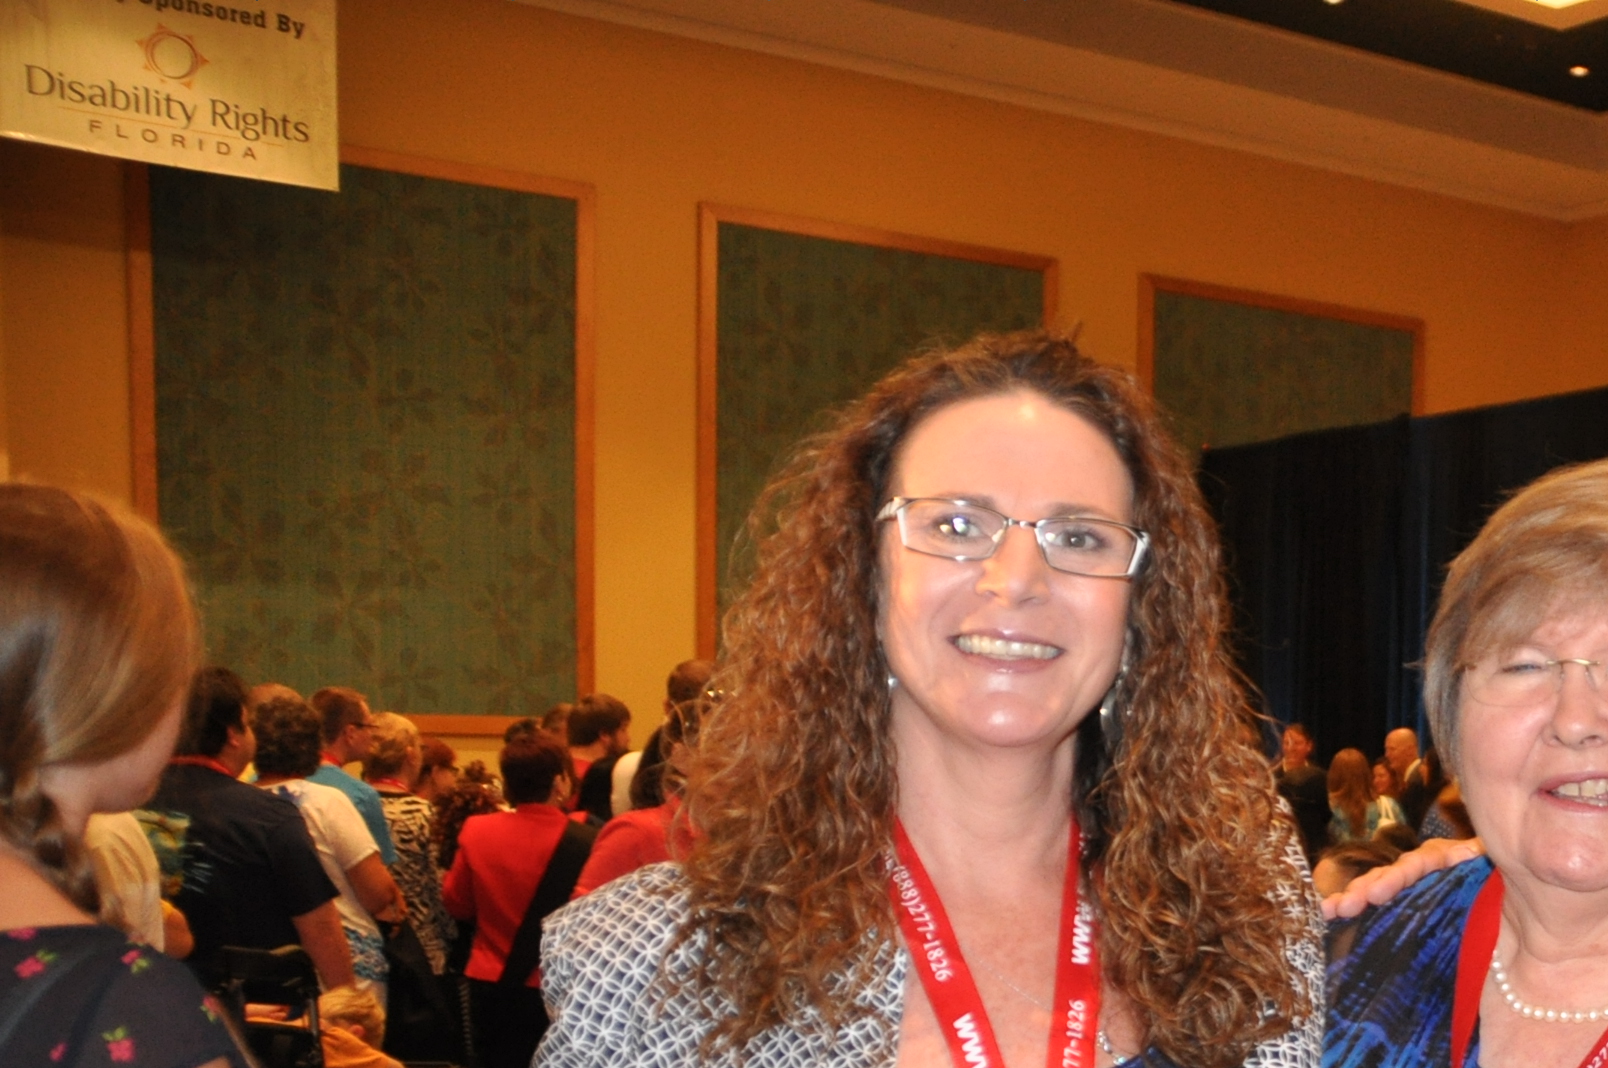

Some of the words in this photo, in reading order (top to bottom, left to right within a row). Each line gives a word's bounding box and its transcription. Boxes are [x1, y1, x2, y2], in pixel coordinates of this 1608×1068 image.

[139, 0, 267, 28] ponsored
[277, 13, 305, 39] By
[24, 64, 198, 130] Disability
[210, 98, 310, 143] Rights
[89, 119, 257, 160] FLORIDA
